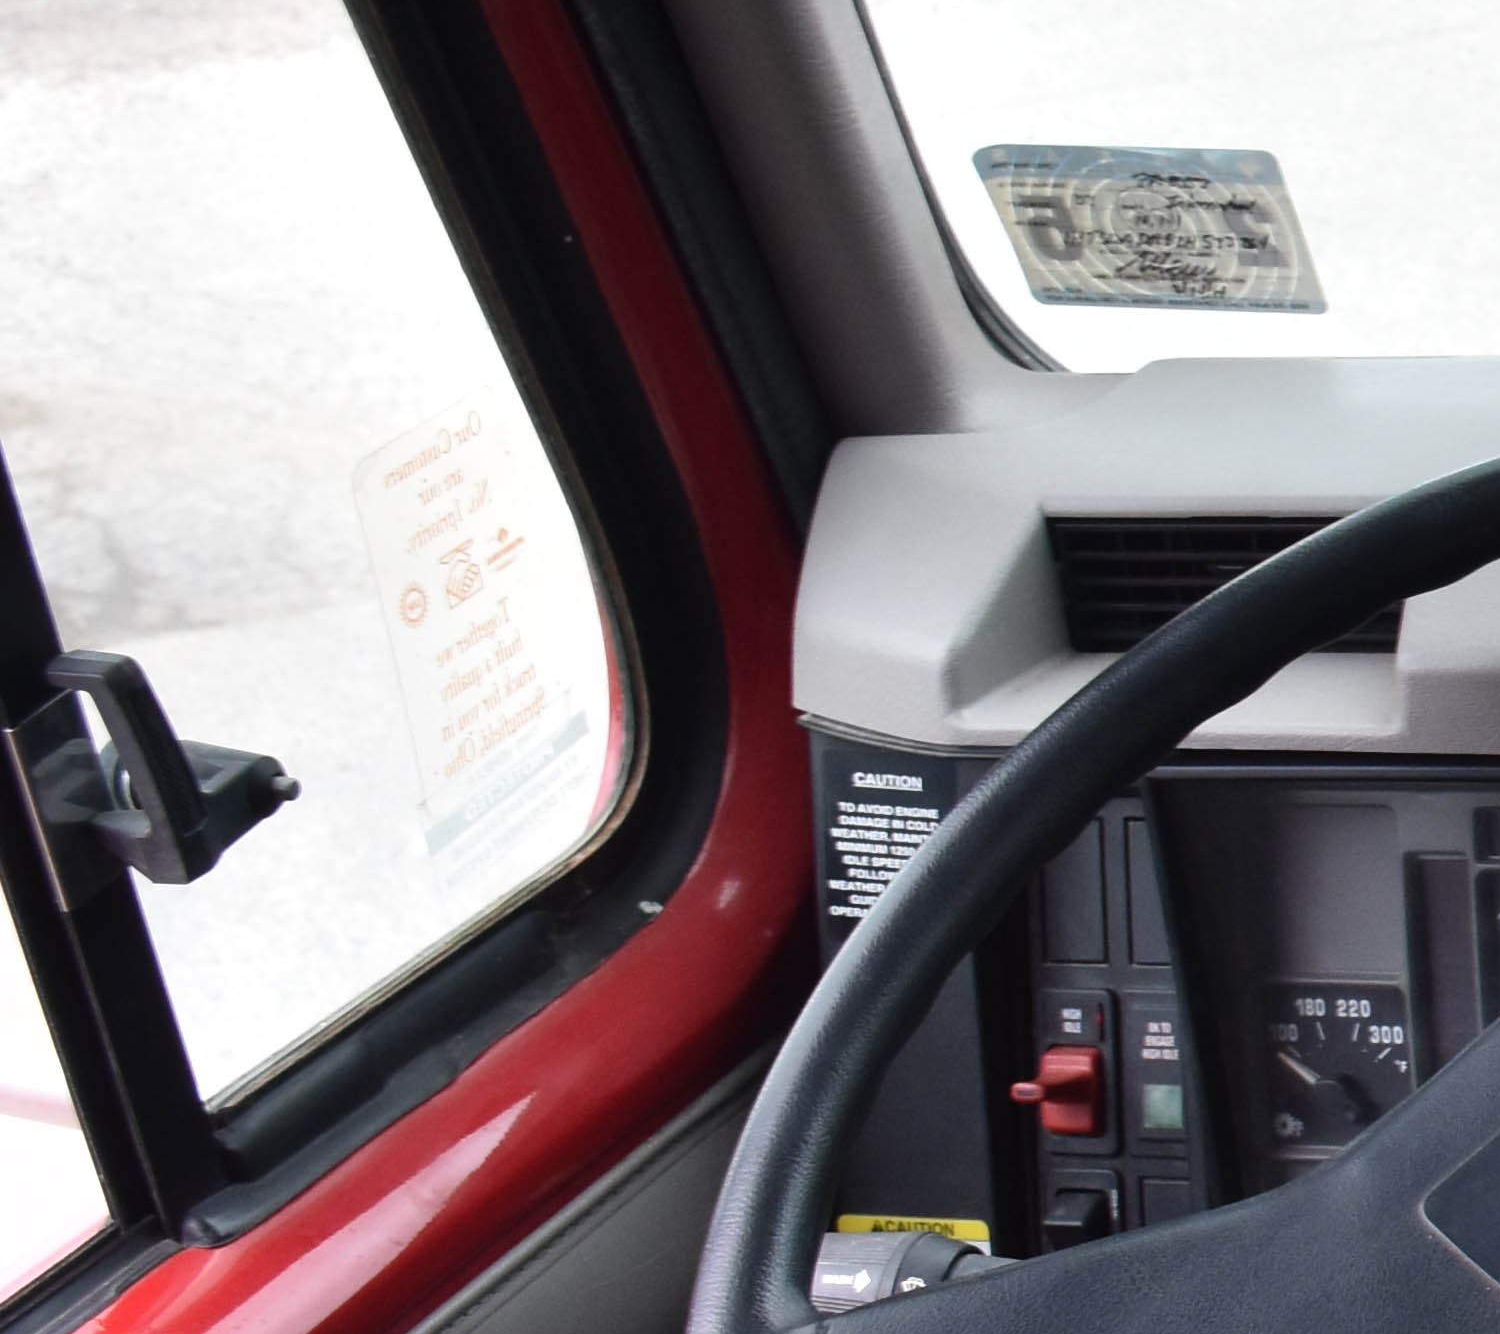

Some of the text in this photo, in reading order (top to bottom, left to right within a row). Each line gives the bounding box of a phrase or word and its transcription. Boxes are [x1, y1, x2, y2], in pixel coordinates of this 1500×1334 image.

[852, 772, 923, 789] CAUTION
[1295, 998, 1325, 1017] 180
[1336, 999, 1371, 1018] 220
[1369, 1025, 1404, 1044] 300
